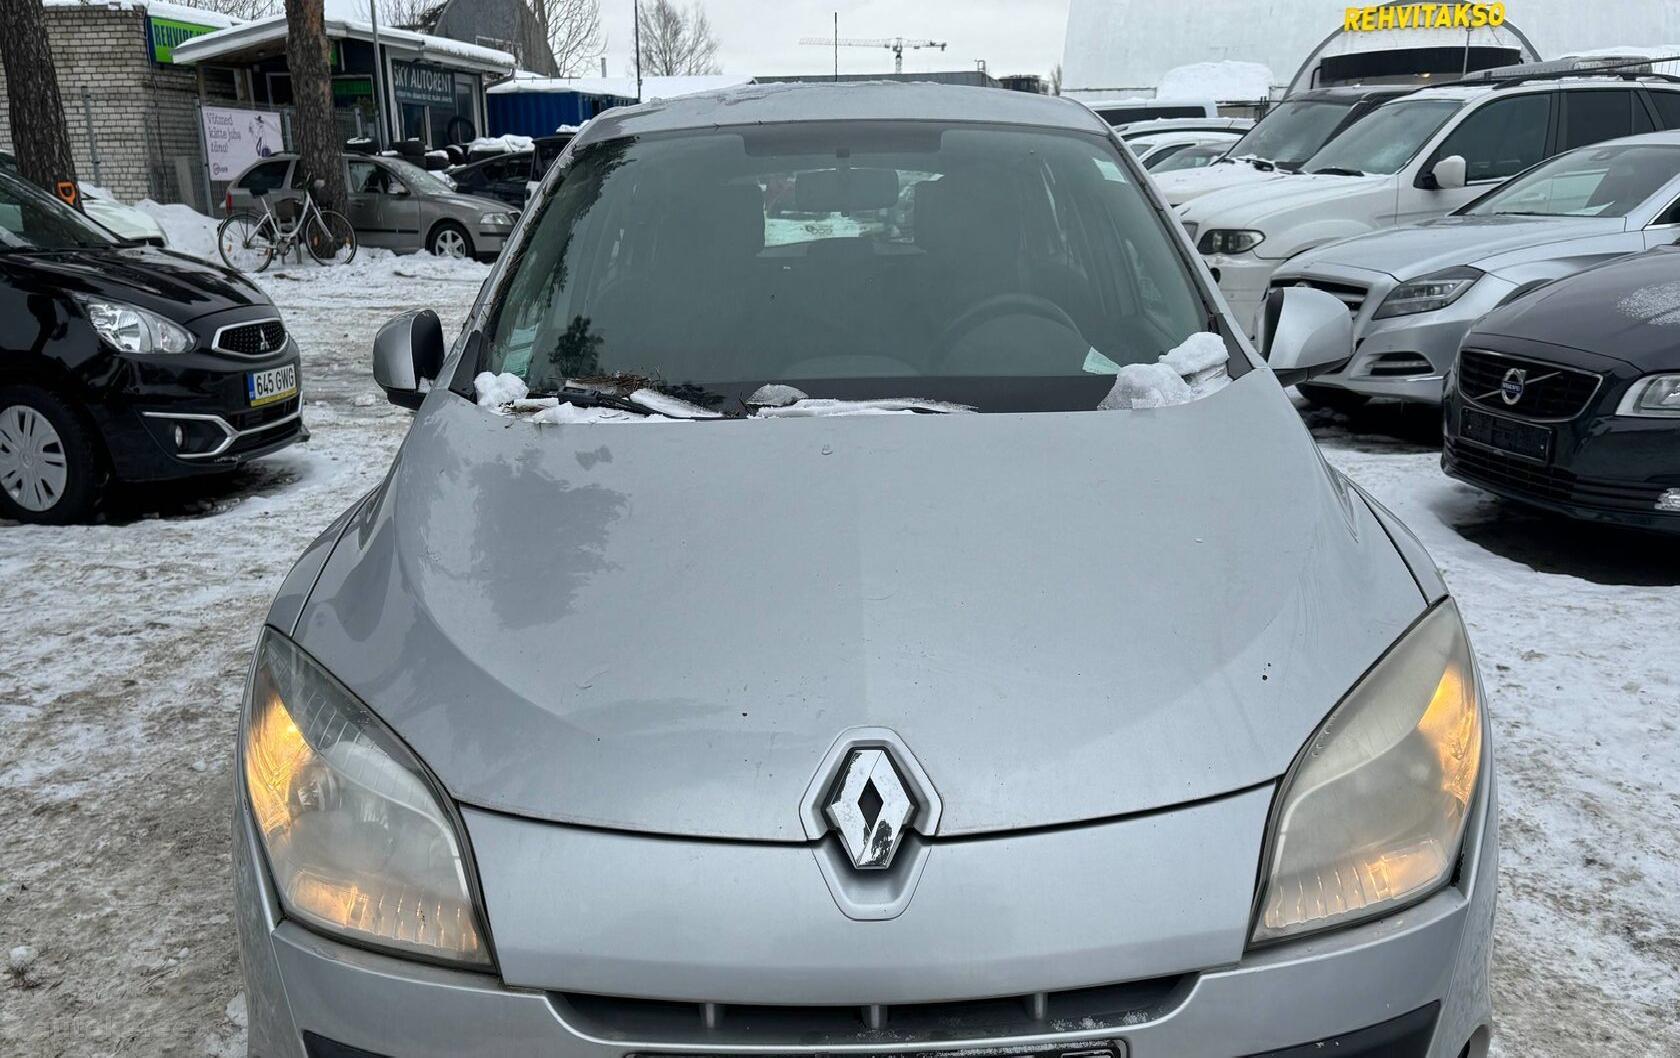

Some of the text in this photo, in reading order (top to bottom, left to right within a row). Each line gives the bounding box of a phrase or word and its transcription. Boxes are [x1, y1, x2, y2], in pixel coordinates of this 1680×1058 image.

[1344, 3, 1506, 32] REHVITAKSO
[393, 65, 452, 93] SKY AUTORENT
[256, 367, 295, 396] 645 GWG
